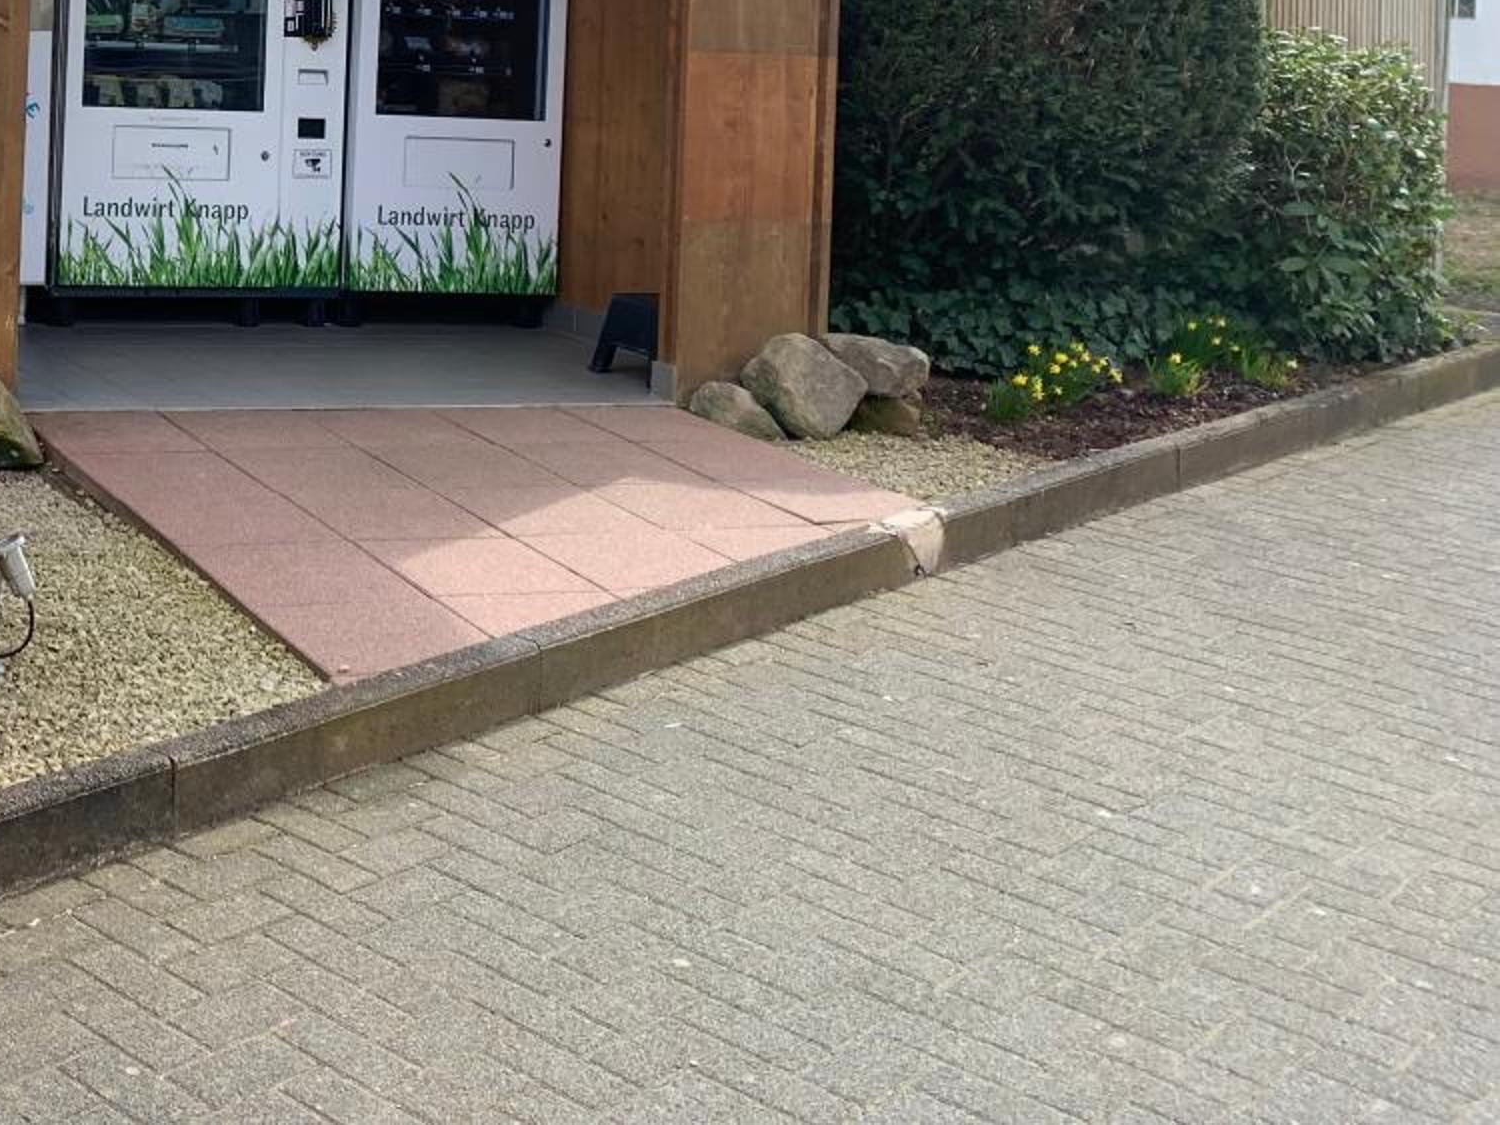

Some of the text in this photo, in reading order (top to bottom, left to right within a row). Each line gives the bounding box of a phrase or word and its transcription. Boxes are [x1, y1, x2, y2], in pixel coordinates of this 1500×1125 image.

[83, 195, 249, 221] Landwirt Knapp
[377, 204, 535, 233] Landwirt Knapp
